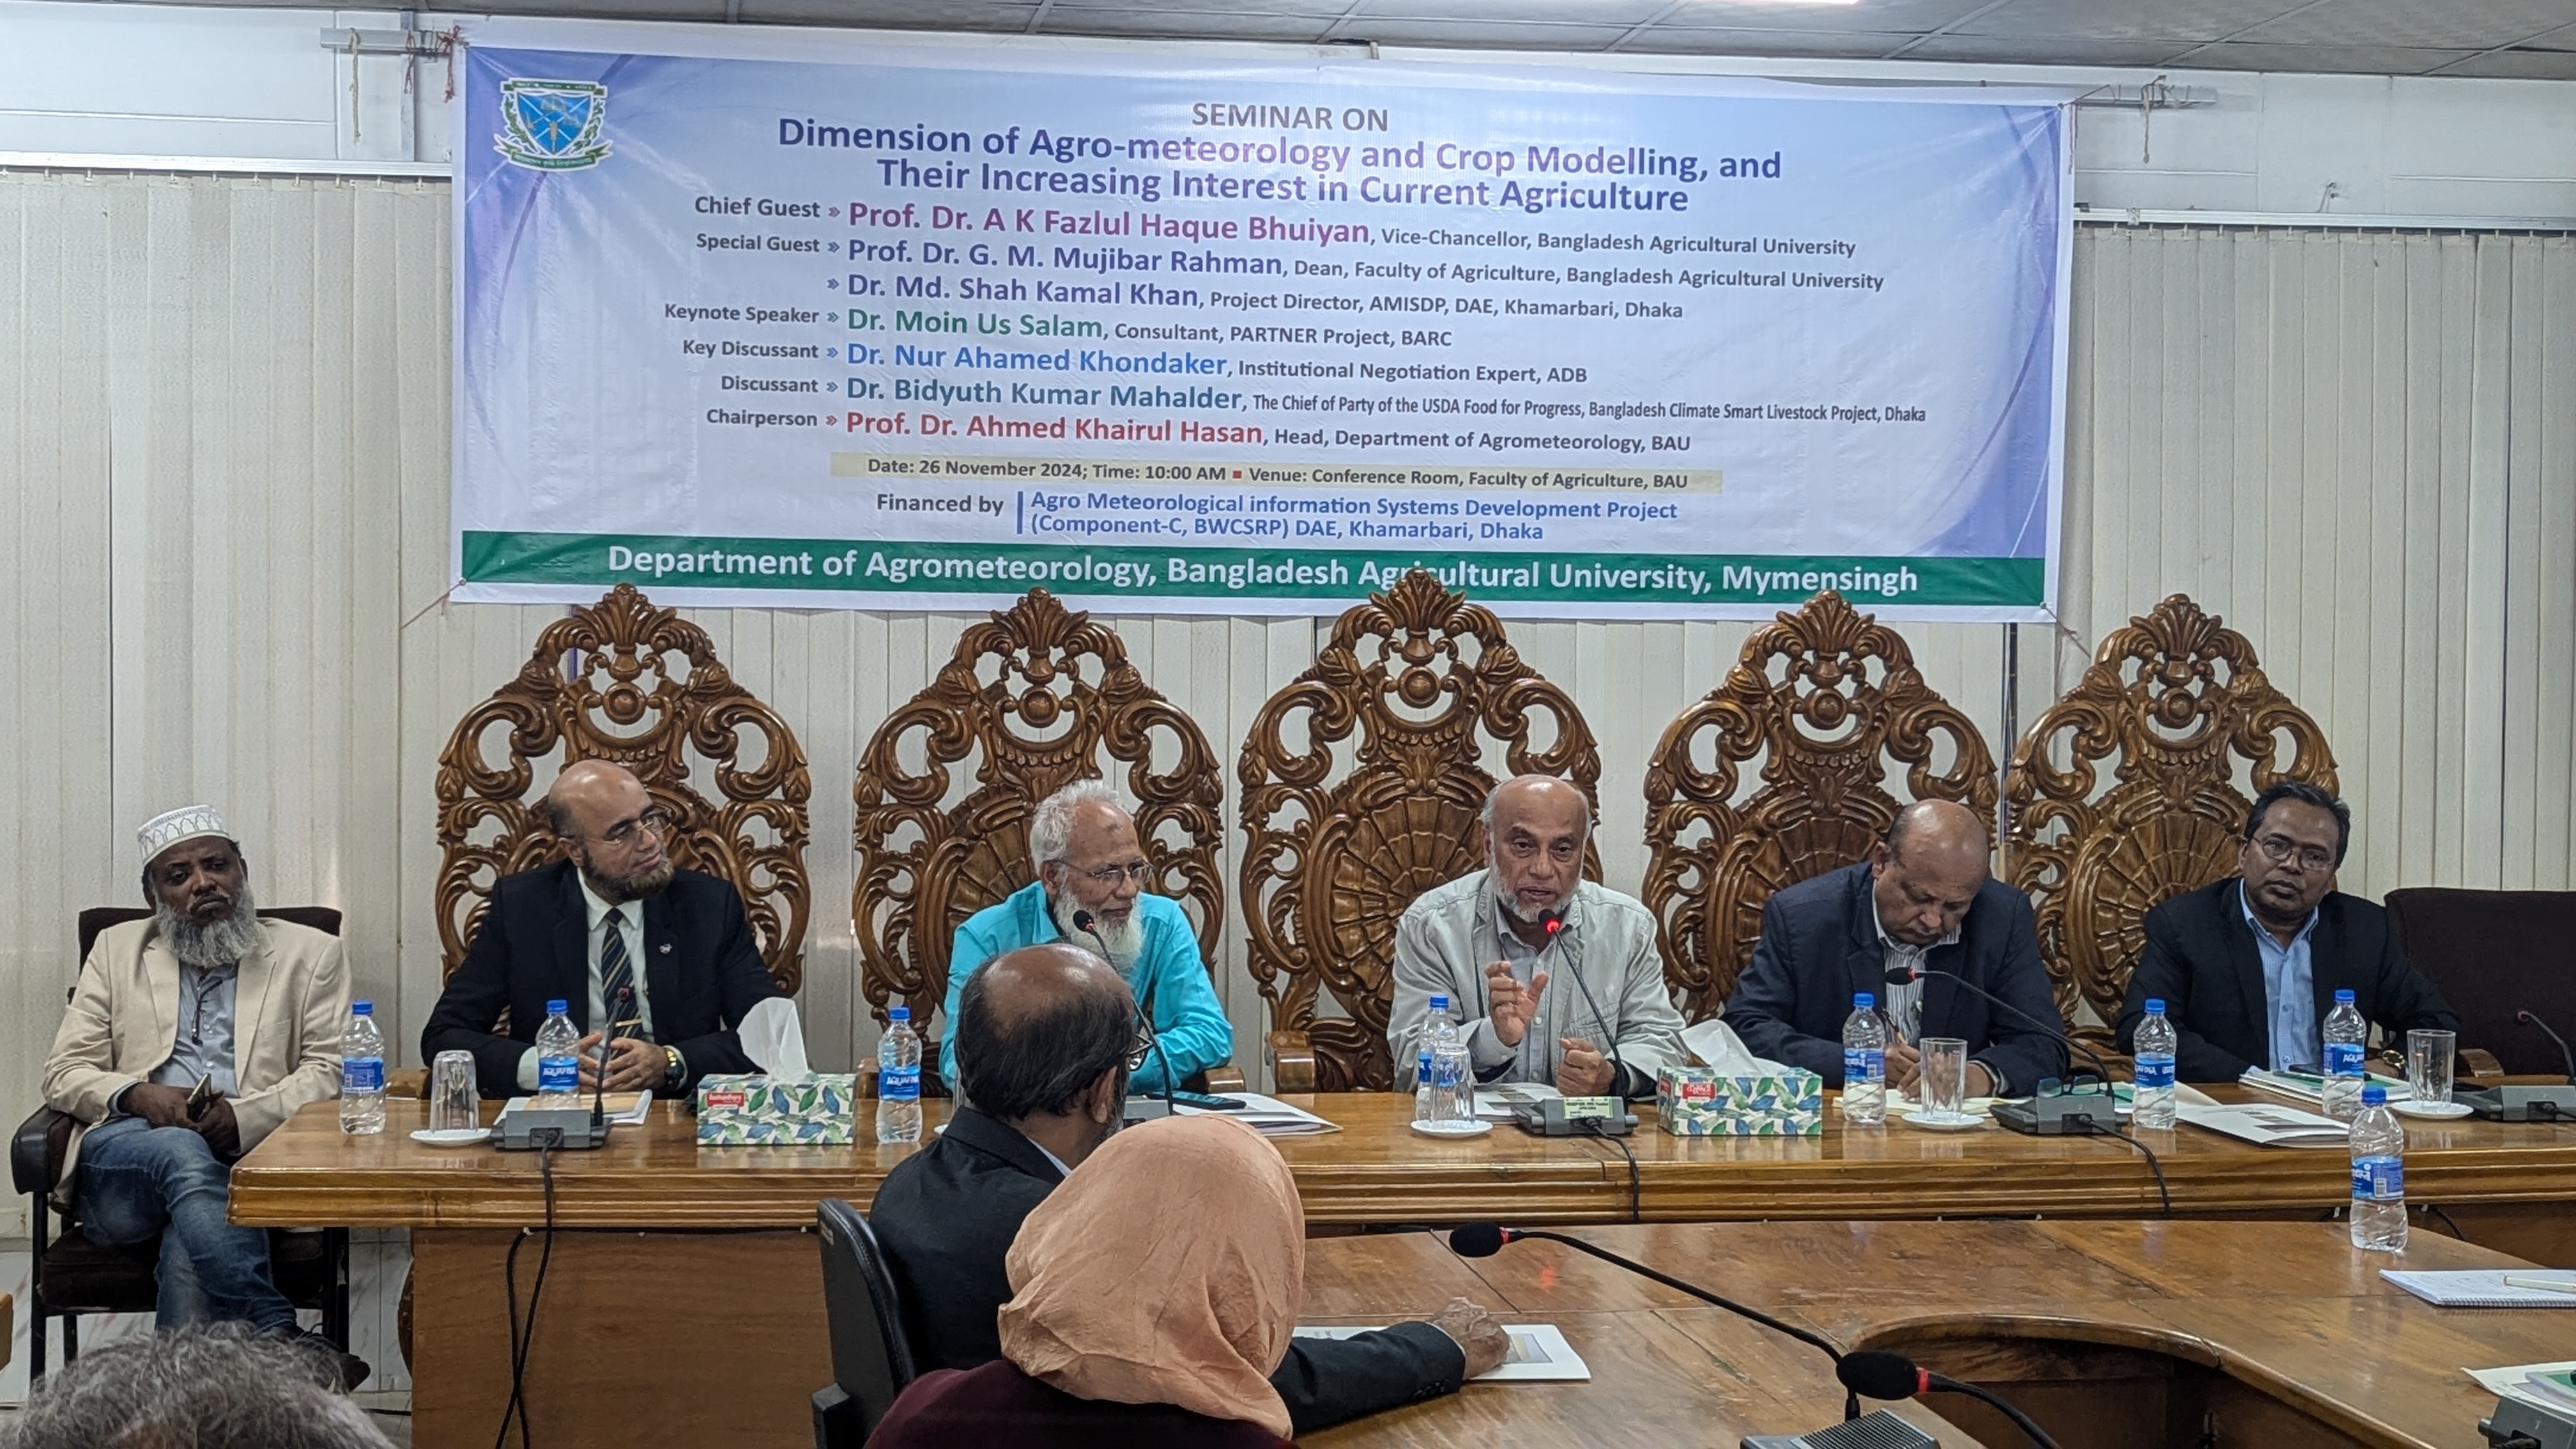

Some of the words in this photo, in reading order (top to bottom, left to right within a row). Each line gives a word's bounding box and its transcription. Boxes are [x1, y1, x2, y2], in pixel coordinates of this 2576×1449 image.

[1193, 103, 1332, 130] SEMINAR
[1343, 109, 1387, 131] ON
[780, 119, 970, 152] Dimension
[983, 126, 1020, 154] of
[1029, 130, 1350, 172] Agro-meteorology
[1361, 141, 1423, 168] and
[1437, 144, 1514, 177] Crop
[1528, 146, 1707, 182] Modelling,
[1720, 151, 1780, 178] and
[877, 158, 970, 188] Their
[983, 163, 1161, 202] Increasing
[1174, 171, 1306, 200] Interest
[1319, 174, 1347, 201] in
[1361, 176, 1489, 206] Current
[1500, 181, 1688, 213] Agriculture
[695, 196, 751, 215] Chief
[758, 199, 820, 217] Guest
[850, 203, 919, 227] Prof.
[933, 206, 972, 230] Dr.
[983, 208, 1005, 231] A
[1017, 210, 1034, 232] K
[1046, 210, 1129, 235] Fazlul
[1142, 213, 1238, 243] Haque
[1250, 216, 1375, 247] Bhuiyan,
[1381, 229, 1531, 250] Vice-Chancellor,
[1538, 233, 1644, 255] Bangladesh
[1650, 236, 1756, 258] Agricultural
[1764, 238, 1855, 258] University
[697, 233, 761, 251] Special
[767, 236, 820, 252] Guest
[850, 240, 912, 262] Prof.
[924, 243, 959, 264] Dr.
[969, 244, 997, 265] G.
[1009, 245, 1043, 266] M.
[1054, 247, 1162, 274] Mujibar
[1172, 250, 1287, 277] Rahman,
[1295, 261, 1348, 279] Dean,
[1356, 262, 1422, 281] Faculty
[1427, 263, 1446, 279] of
[1452, 264, 1560, 284] Agriculture,
[1568, 268, 1672, 286] Bangladesh
[1678, 270, 1785, 288] Agricultural
[1793, 273, 1883, 292] University
[849, 274, 885, 296] Dr.
[897, 276, 949, 298] Md.
[960, 277, 1026, 300] Shah
[1038, 281, 1123, 303] Kamal
[1131, 283, 1204, 309] Khan,
[1211, 292, 1277, 310] Project
[1284, 294, 1363, 313] Director,
[1370, 296, 1448, 315] AMISDP,
[1456, 298, 1498, 316] DAE,
[1505, 299, 1619, 319] Khamarbari,
[1626, 302, 1682, 318] Dhaka
[665, 303, 740, 321] Keynote
[746, 307, 819, 324] Speaker
[849, 309, 885, 330] Dr.
[896, 310, 967, 333] Moin
[978, 313, 1011, 335] Us
[1020, 314, 1108, 341] Salam,
[1116, 323, 1223, 344] Consultant,
[1231, 327, 1317, 343] PARTNER
[1324, 329, 1395, 348] Project,
[1402, 331, 1452, 346] BARC
[684, 340, 716, 360] Key
[723, 341, 818, 358] Discussant
[848, 343, 884, 364] Dr.
[896, 345, 946, 367] Nur
[954, 346, 1070, 371] Ahamed
[1080, 350, 1232, 378] Khondaker,
[1239, 361, 1353, 378] Institutional
[1361, 364, 1469, 382] Negotiation
[1476, 366, 1540, 384] Expert,
[1547, 368, 1587, 382] ADB
[722, 376, 818, 392] Discussant
[848, 378, 884, 399] Dr.
[896, 379, 1001, 406] Bidyuth
[1013, 383, 1101, 405] Kumar
[1111, 386, 1246, 411] Mahalder,
[1253, 394, 1278, 410] The
[1282, 395, 1318, 410] Chief
[1321, 395, 1335, 411] of
[1339, 397, 1374, 415] Party
[1379, 397, 1393, 412] of
[1395, 397, 1418, 412] the
[1423, 399, 1460, 413] USDA
[1464, 399, 1497, 414] Food
[1501, 399, 1521, 414] for
[1525, 401, 1584, 418] Progress,
[1590, 401, 1666, 420] Bangladesh
[1670, 402, 1720, 418] Climate
[1724, 404, 1763, 418] Smart
[1768, 404, 1827, 420] Livestock
[1832, 406, 1880, 424] Project,
[1885, 406, 1925, 421] Dhaka
[707, 409, 817, 427] Chairperson
[848, 412, 910, 434] Prof.
[921, 415, 957, 435] Dr.
[967, 415, 1065, 438] Ahmed
[1076, 418, 1170, 440] Khairul
[1181, 421, 1268, 446] Hasan,
[1275, 429, 1328, 447] Head,
[1336, 431, 1449, 448] Department
[1455, 432, 1475, 447] of
[1479, 433, 1645, 453] Agrometeorology,
[1652, 436, 1690, 450] BAU
[868, 459, 914, 473] Date:
[919, 460, 940, 473] 26
[946, 461, 1036, 476] November
[1041, 463, 1087, 480] 2024;
[1092, 464, 1140, 479] Time:
[1146, 466, 1192, 480] 10:00
[1196, 467, 1225, 480] AM
[1249, 468, 1307, 482] Venue:
[1312, 469, 1406, 484] Conference
[1411, 471, 1463, 487] Room,
[1469, 471, 1528, 488] Faculty
[1531, 472, 1549, 486] of
[1552, 473, 1648, 490] Agriculture,
[1653, 475, 1687, 488] BAU
[878, 494, 971, 512] Financed
[979, 496, 1004, 516] by
[1031, 492, 1080, 512] Agro
[1088, 493, 1243, 514] Meteorological
[1250, 496, 1370, 514] information
[1377, 498, 1459, 518] Systems
[1466, 500, 1601, 520] Development
[1607, 502, 1677, 521] Project
[1032, 514, 1187, 537] (Component-C,
[1195, 519, 1288, 539] BWCSRP)
[1296, 520, 1342, 539] DAE,
[1350, 520, 1473, 541] Khamarbari,
[1482, 523, 1542, 539] Dhaka
[610, 546, 812, 577] Department
[823, 551, 857, 576] of
[865, 553, 1156, 586] Agrometeorology,
[1169, 558, 1347, 588] Bangladesh
[1358, 561, 1539, 591] Agrultural
[1551, 564, 1711, 594] University,
[1722, 566, 1917, 594] Mymensingh
